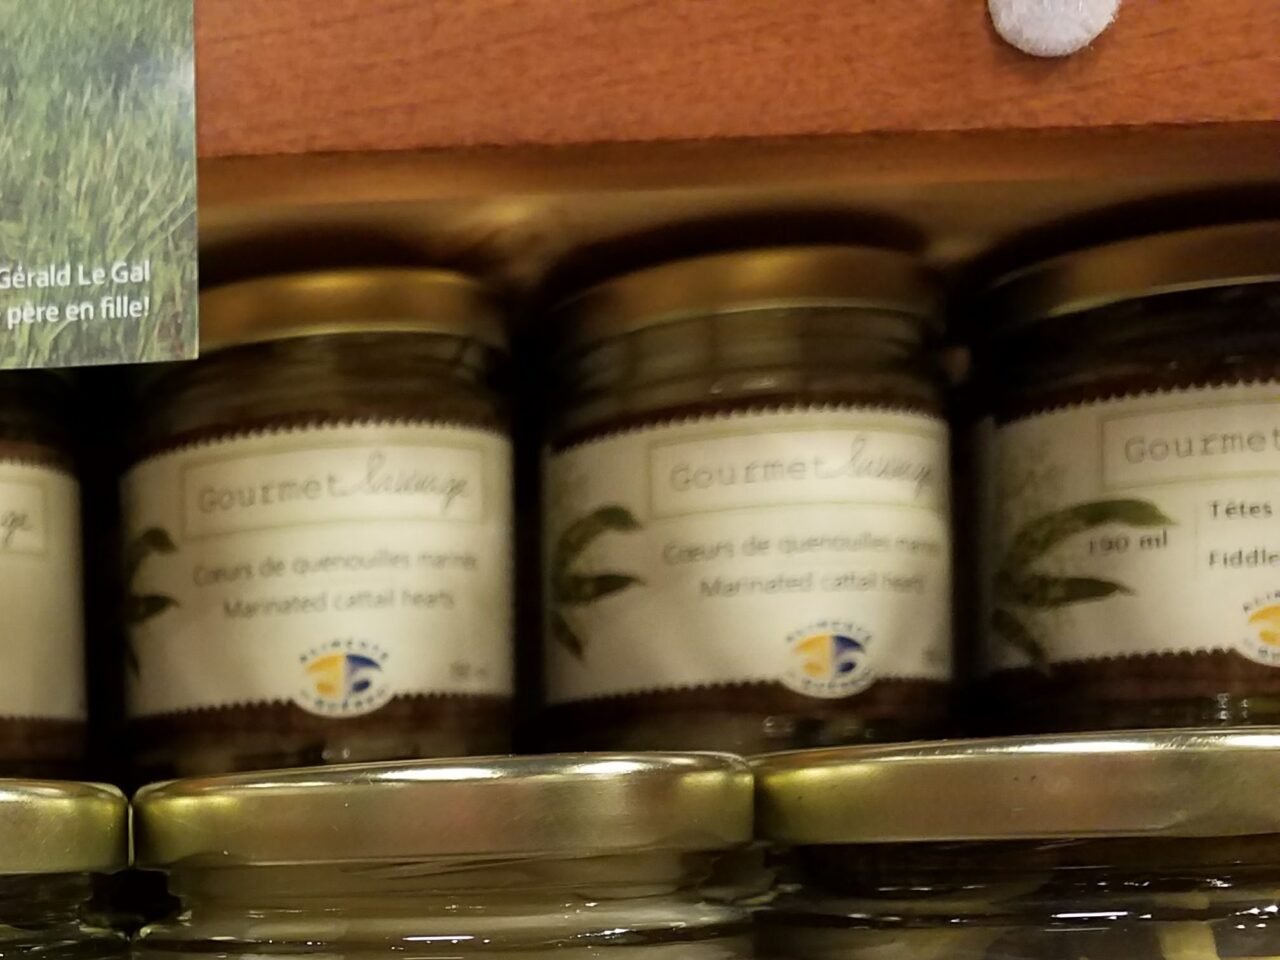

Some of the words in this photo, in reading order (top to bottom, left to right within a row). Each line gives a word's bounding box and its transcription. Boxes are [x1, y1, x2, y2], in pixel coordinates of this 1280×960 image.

[78, 265, 106, 286] Le
[111, 260, 151, 284] Gal
[6, 302, 59, 330] père
[65, 302, 95, 321] en
[100, 296, 151, 319] fille!
